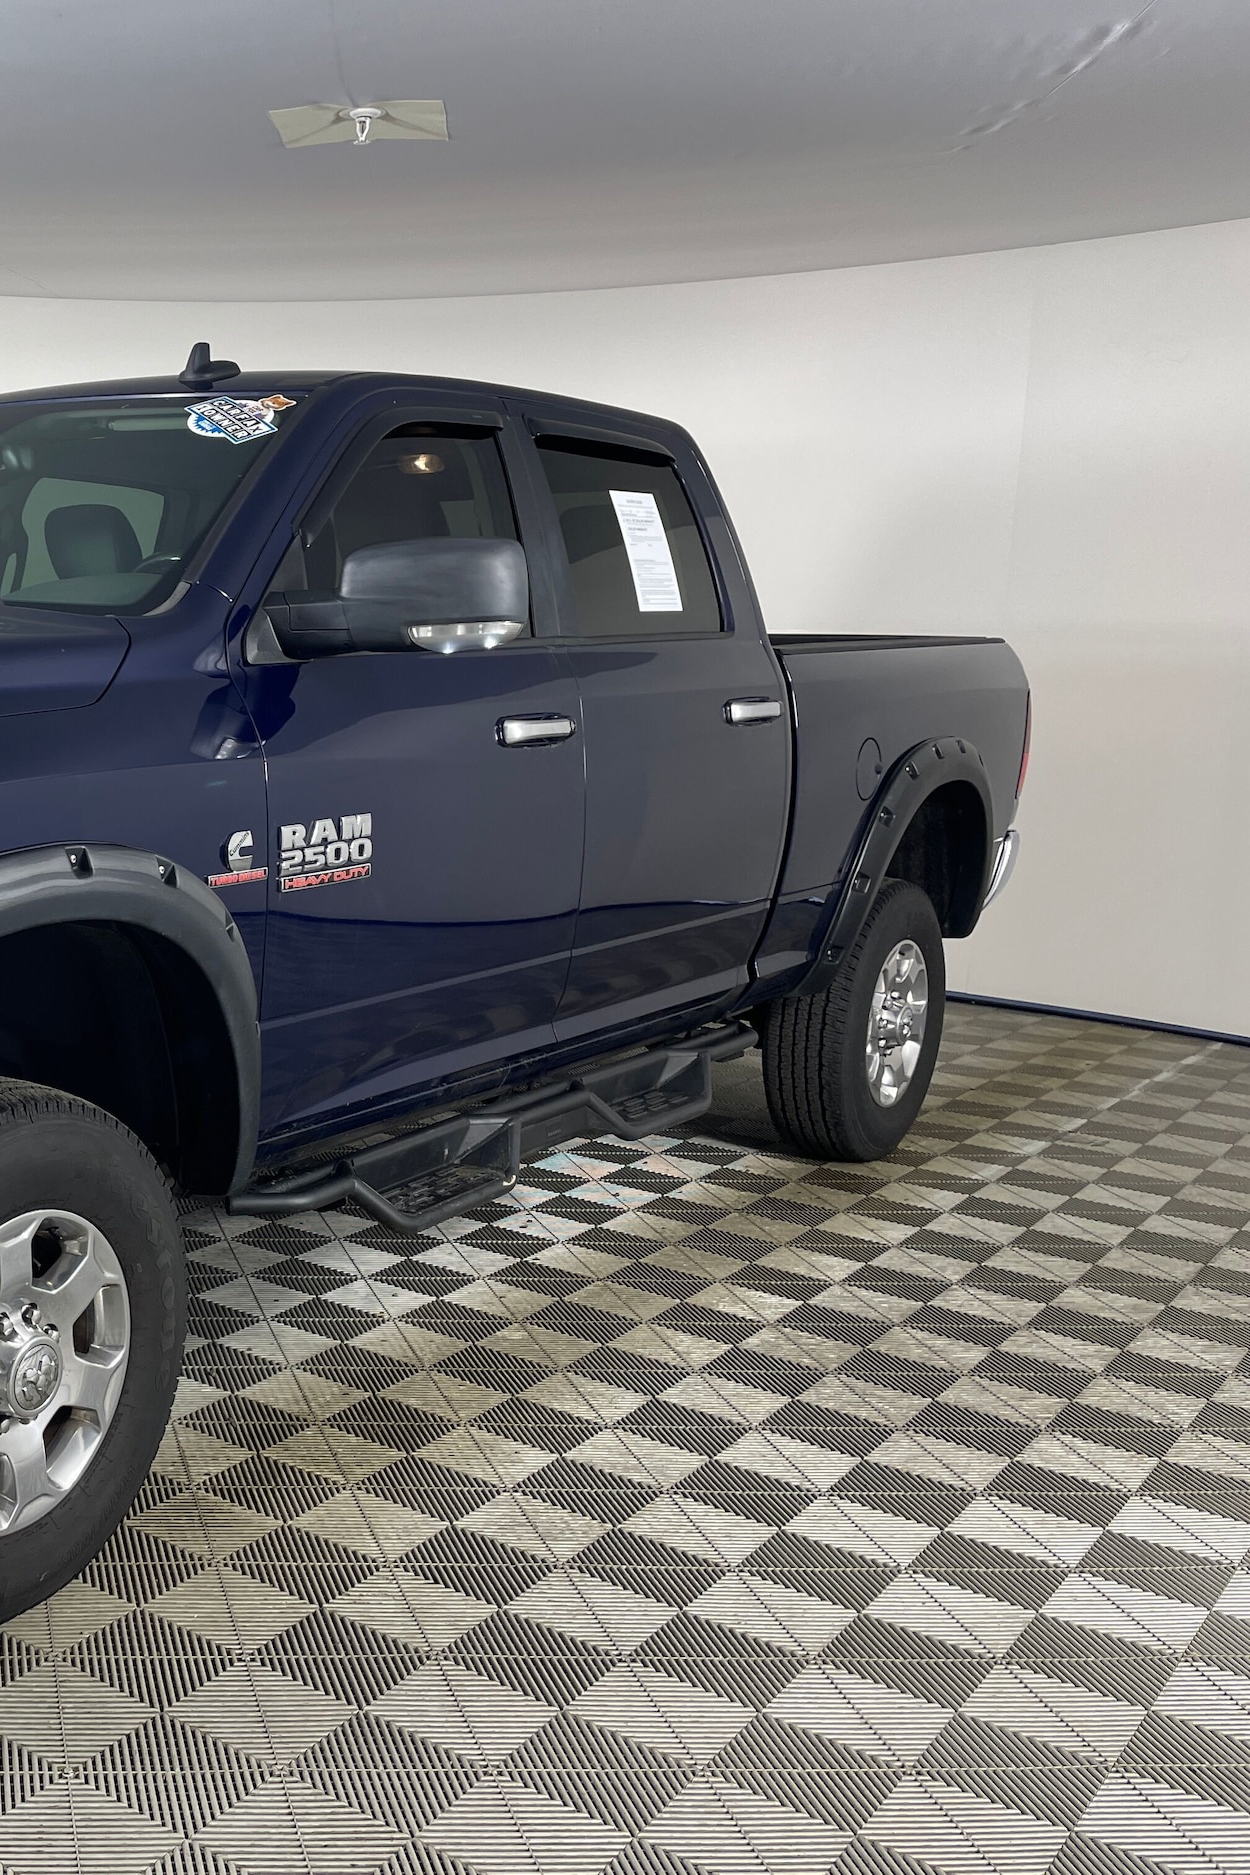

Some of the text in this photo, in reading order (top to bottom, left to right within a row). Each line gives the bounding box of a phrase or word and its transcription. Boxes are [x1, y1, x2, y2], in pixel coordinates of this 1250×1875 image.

[212, 400, 264, 433] CARFAX
[280, 812, 372, 850] RAM
[280, 837, 373, 877] 2500
[284, 866, 369, 890] HEAVY DUTY
